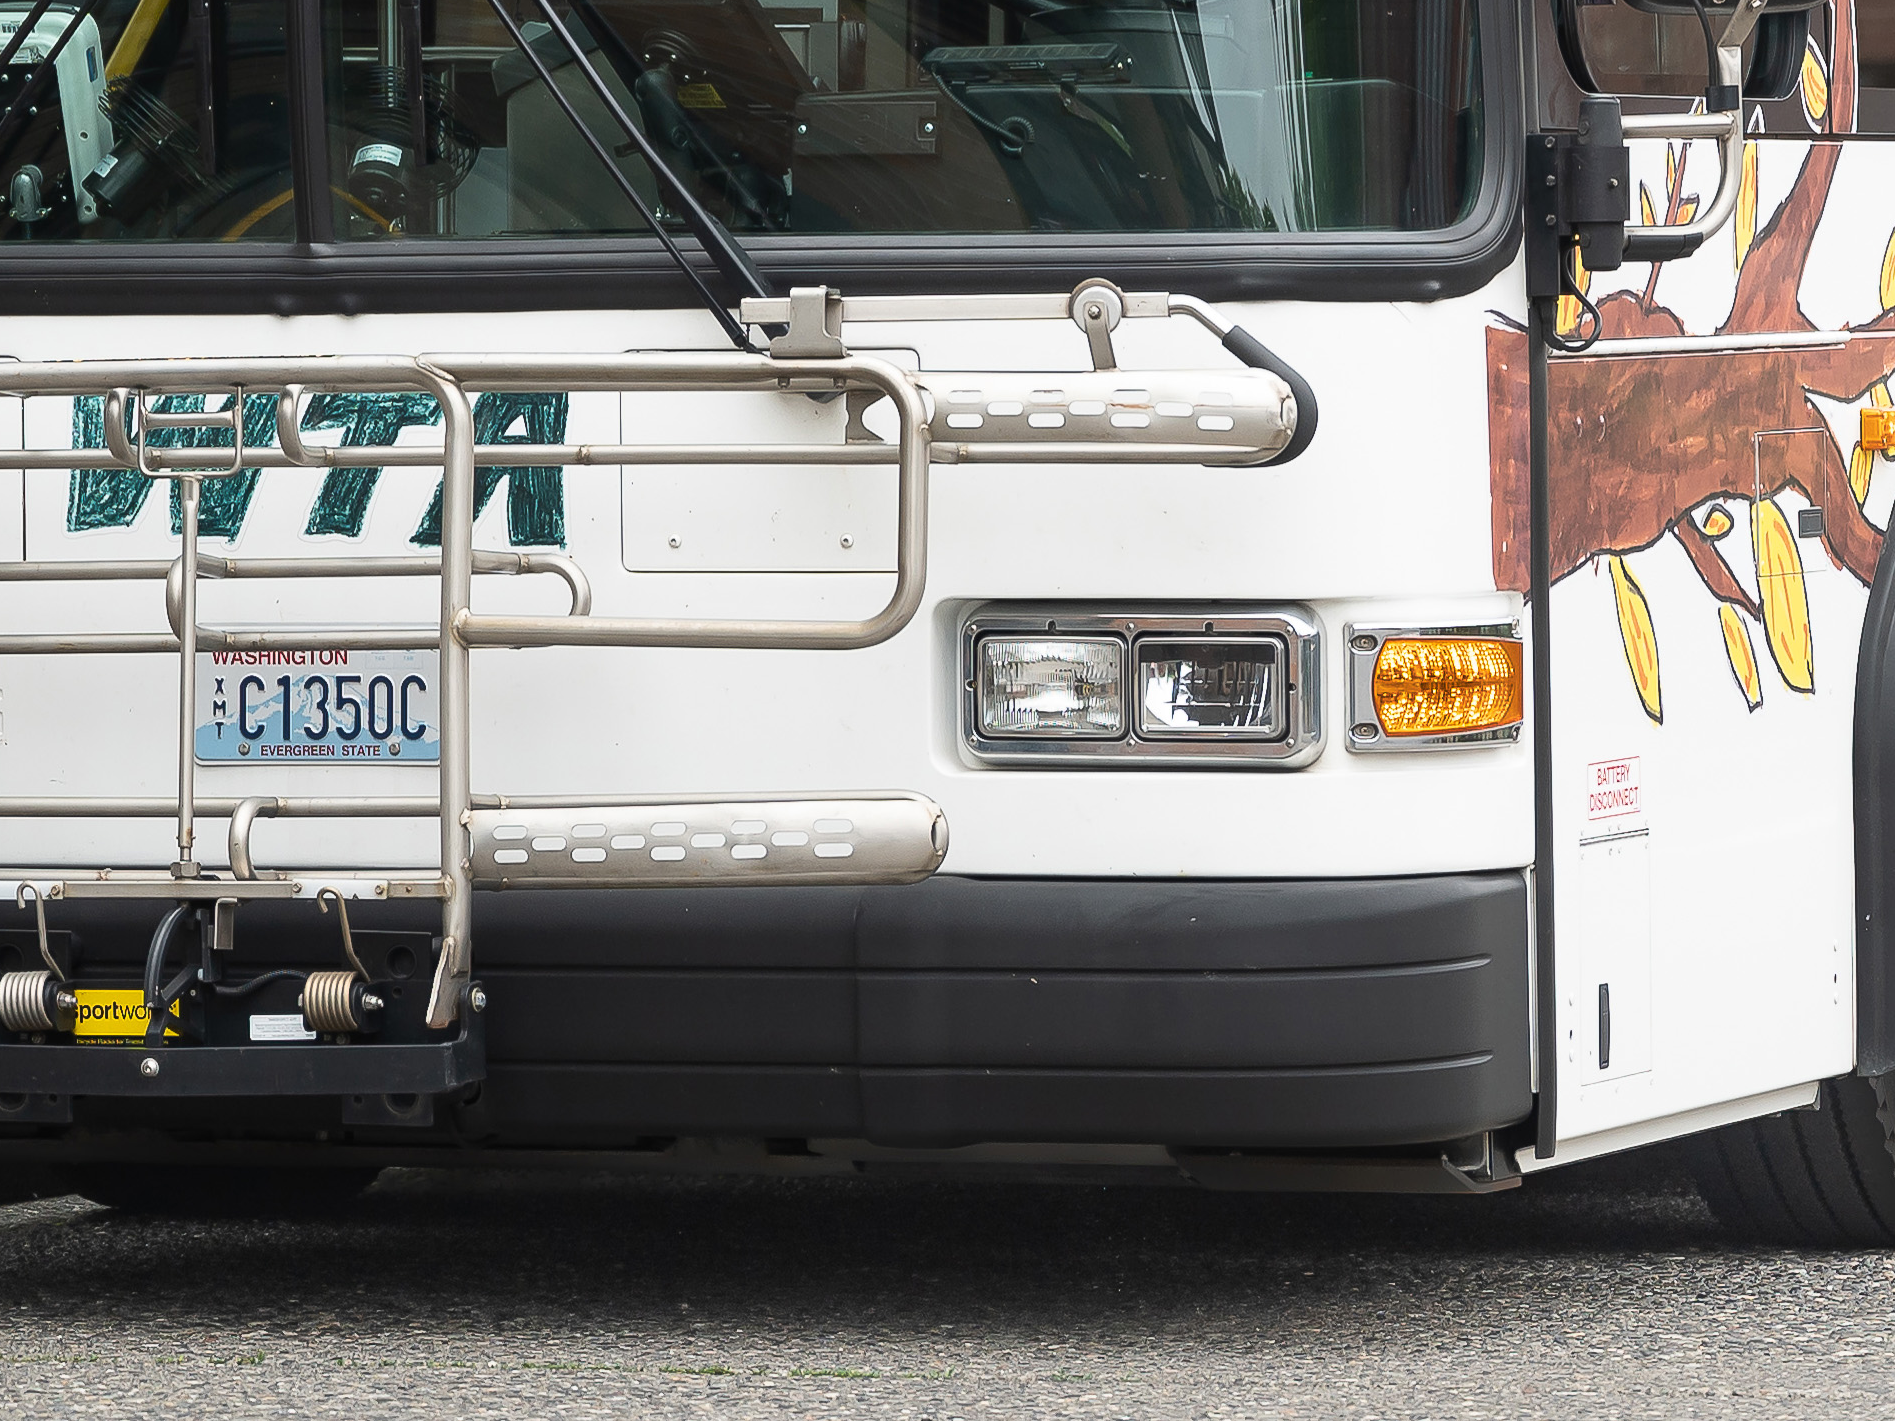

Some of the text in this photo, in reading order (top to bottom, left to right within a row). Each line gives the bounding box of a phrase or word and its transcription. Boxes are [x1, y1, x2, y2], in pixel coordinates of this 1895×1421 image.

[66, 390, 569, 550] WTA
[212, 649, 349, 666] WASHINGTON
[239, 675, 427, 741] C1350C
[260, 744, 381, 757] EVERGREEN STATE
[1597, 763, 1631, 786] BATTERY
[1589, 786, 1639, 812] DISCONNECT
